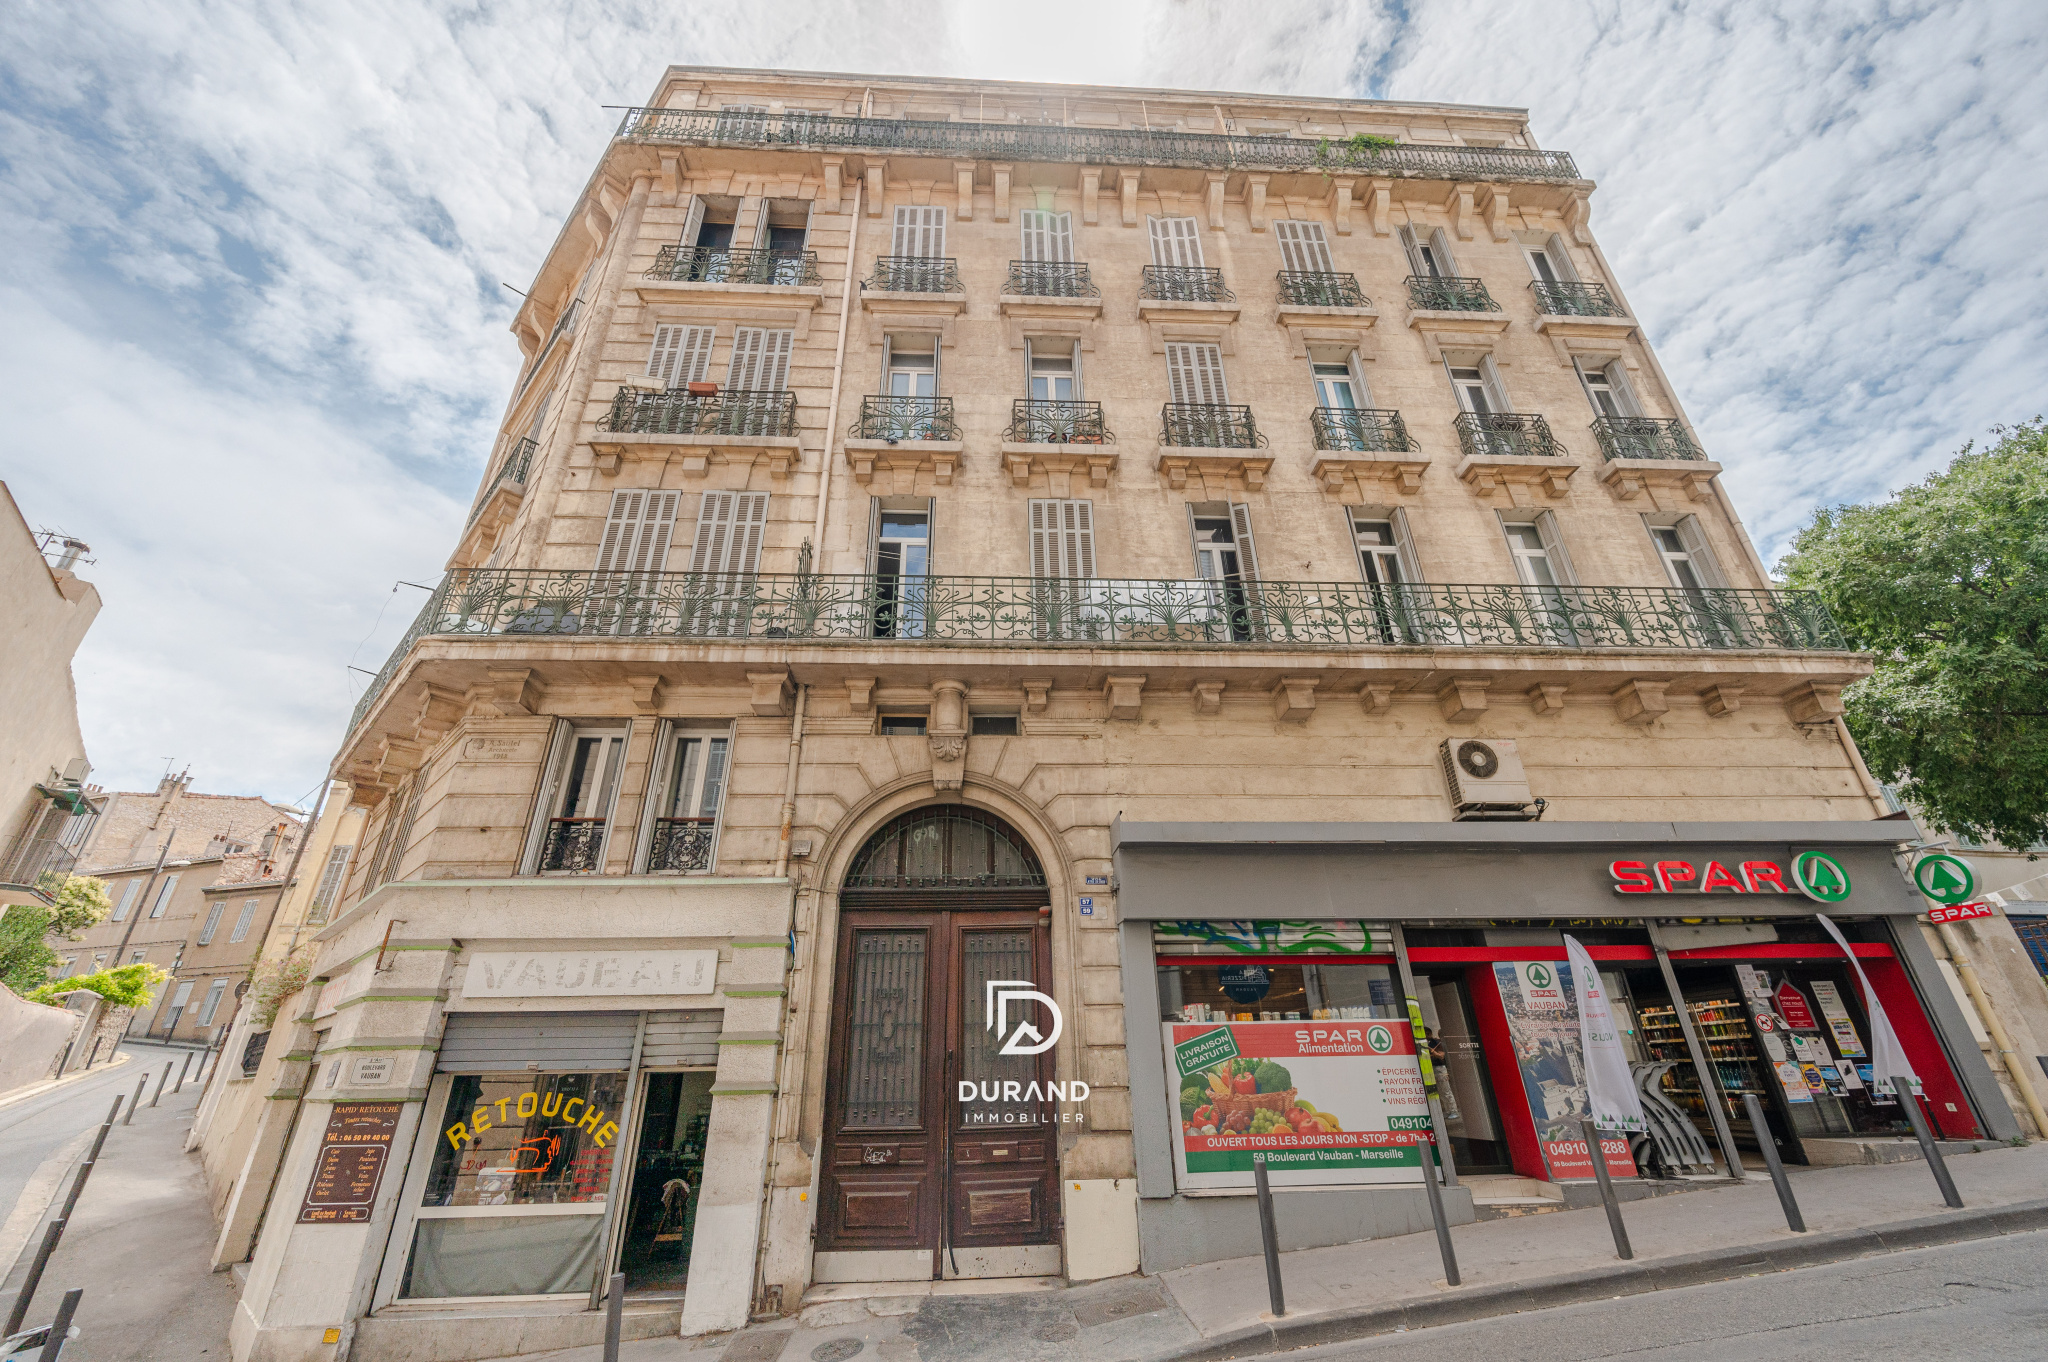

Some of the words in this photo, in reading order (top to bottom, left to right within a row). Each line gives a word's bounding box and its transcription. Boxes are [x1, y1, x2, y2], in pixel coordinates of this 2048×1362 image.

[1608, 860, 1788, 894] SPAR
[1930, 904, 1990, 922] SPAR
[1527, 1001, 1566, 1009] VAUBAN
[1295, 1030, 1362, 1043] SPAR
[1180, 1034, 1228, 1060] LIVRAISON
[1298, 1043, 1364, 1053] Alimentation
[1186, 1044, 1231, 1068] GRATUITE
[1382, 1067, 1417, 1075] ÉPICERIE
[446, 1091, 620, 1151] RETOUCHE
[1391, 1117, 1432, 1129] 049104
[327, 1133, 337, 1141] Tél.
[1207, 1137, 1247, 1147] OUVERT
[1250, 1137, 1277, 1146] TOUS
[1279, 1136, 1297, 1145] LES
[1300, 1135, 1333, 1144] JOURS
[1336, 1135, 1357, 1144] NON
[1396, 1134, 1407, 1142] de
[1253, 1153, 1265, 1161] 59
[1267, 1152, 1315, 1161] Boulevard
[1317, 1150, 1353, 1160] Vauban
[1361, 1150, 1403, 1159] Marseille
[1550, 1142, 1626, 1156] 04910288
